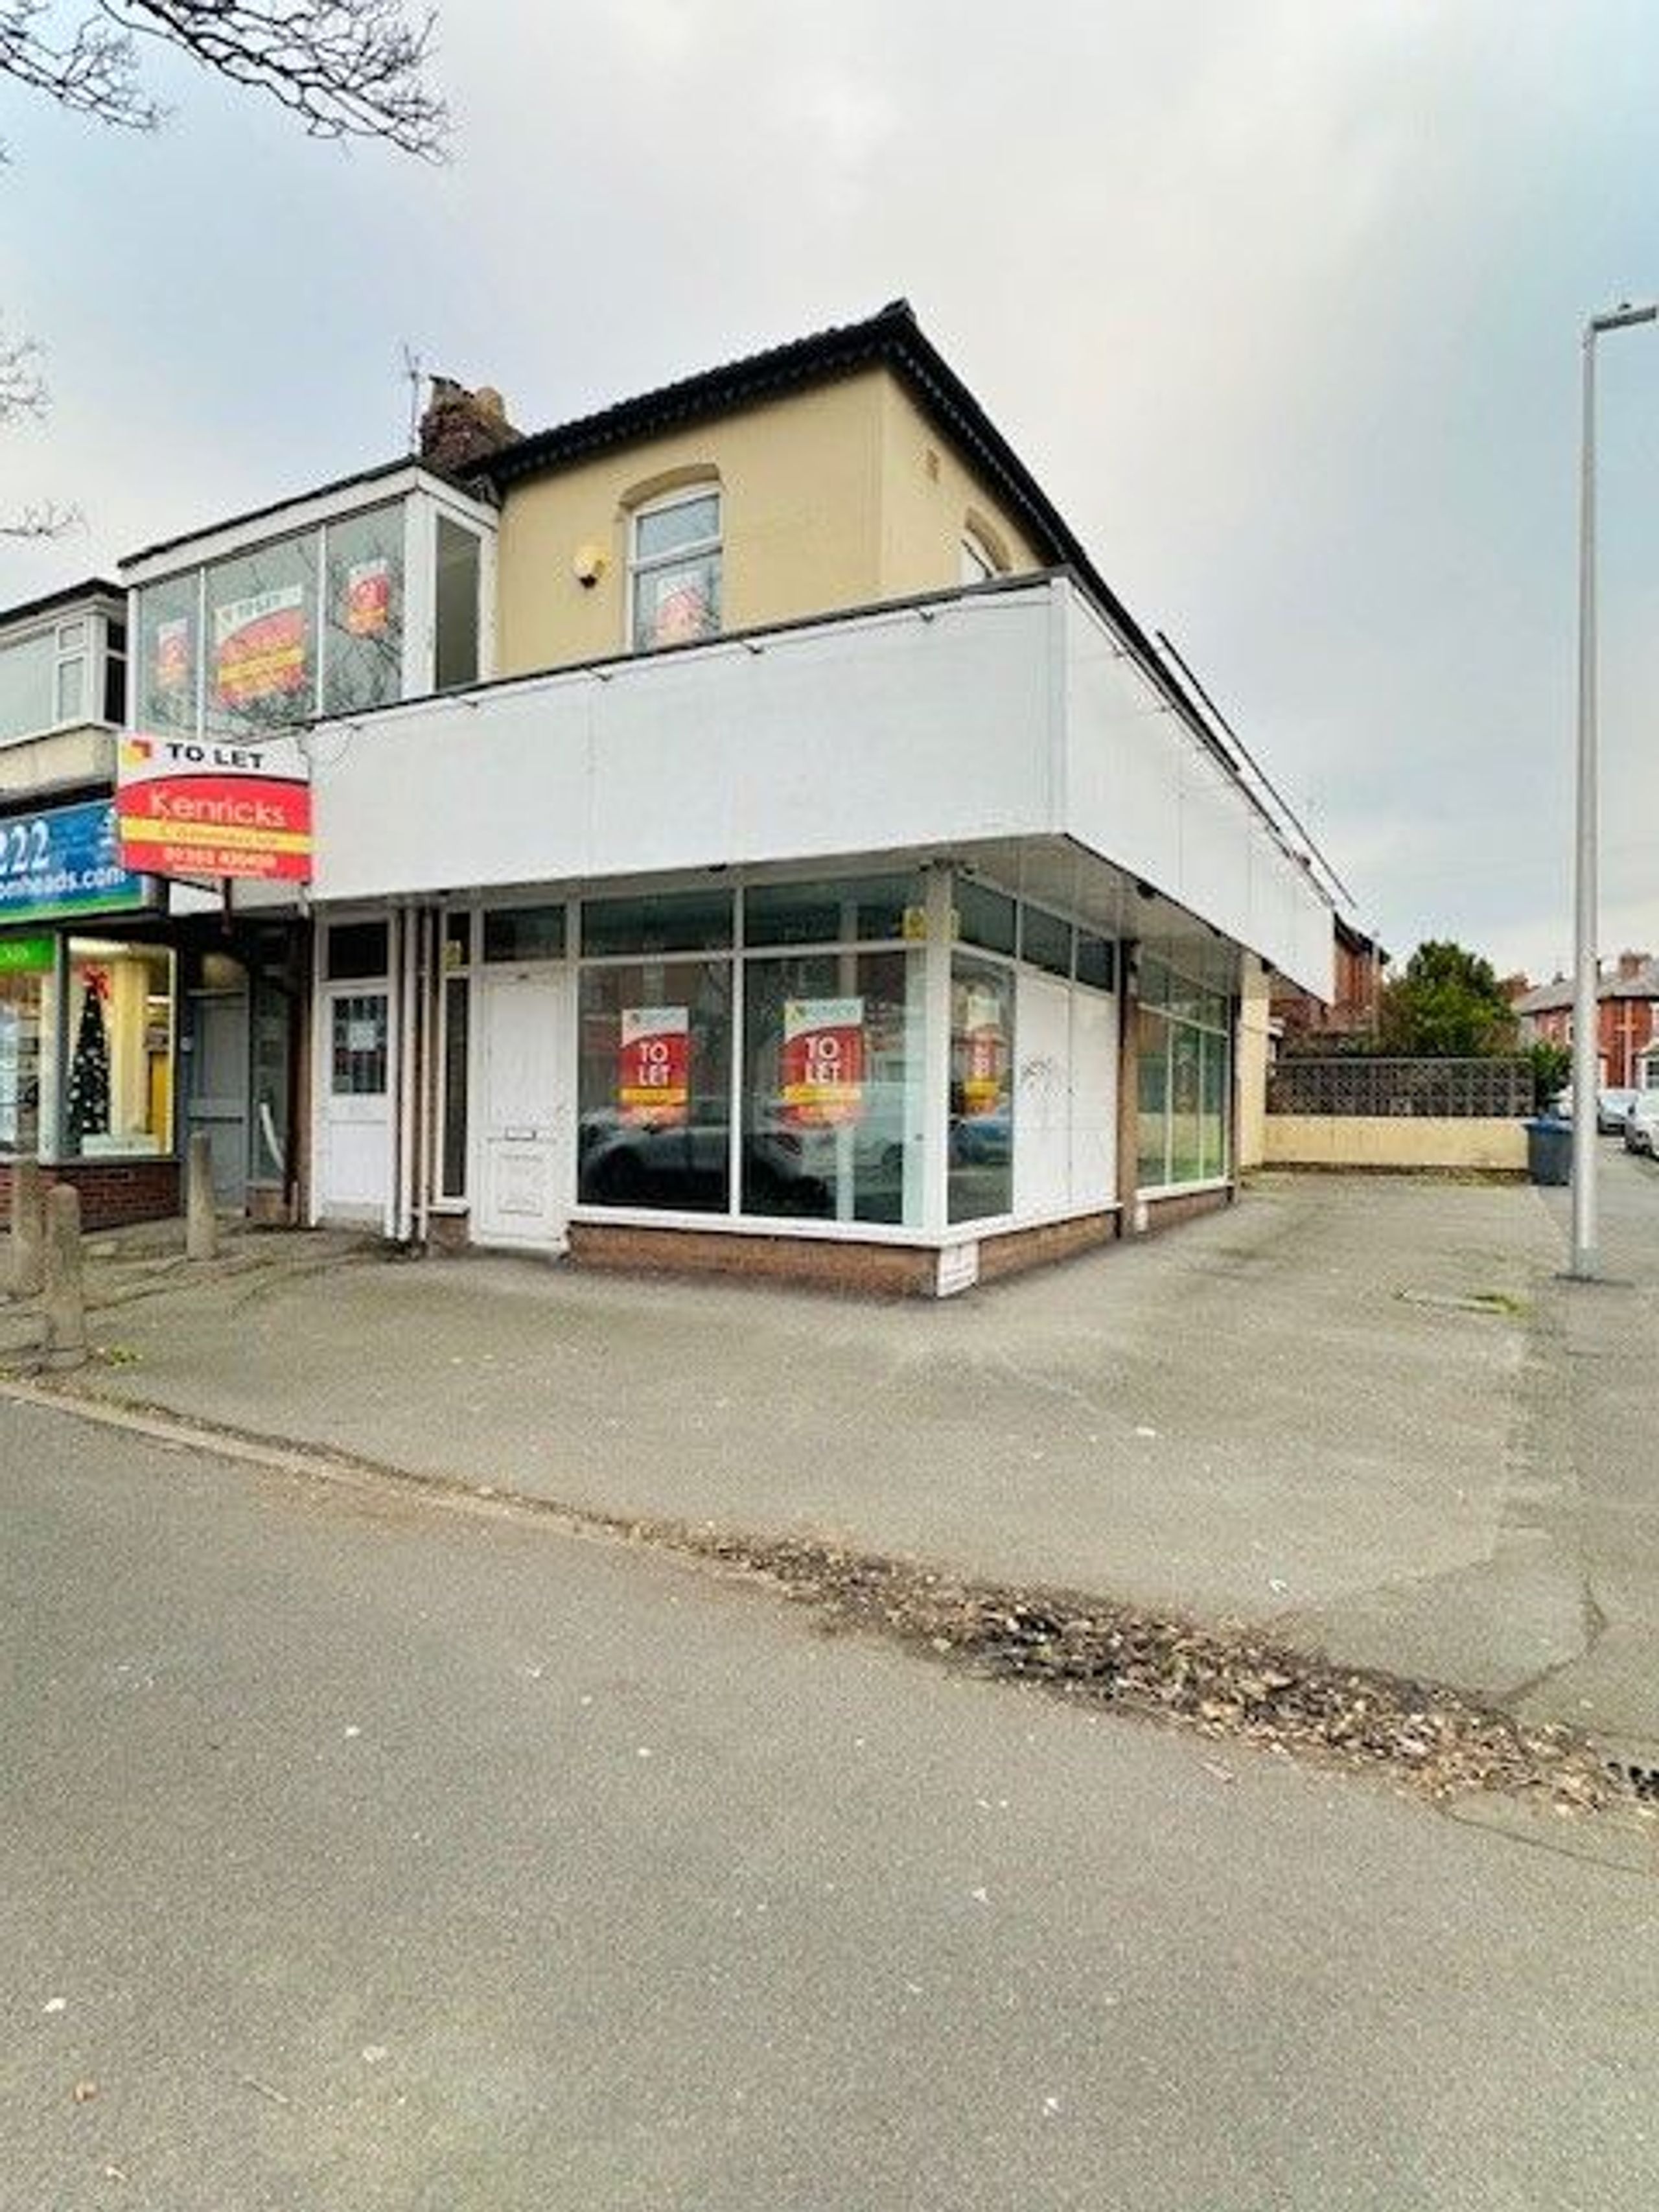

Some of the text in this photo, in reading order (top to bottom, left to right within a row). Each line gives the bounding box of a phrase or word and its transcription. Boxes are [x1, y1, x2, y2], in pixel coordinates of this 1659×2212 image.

[166, 743, 264, 769] TO LET
[148, 787, 286, 828] Kenricks
[639, 1041, 669, 1063] TO
[805, 1036, 840, 1059] TO
[638, 1064, 671, 1086] LET
[805, 1060, 842, 1084] LET
